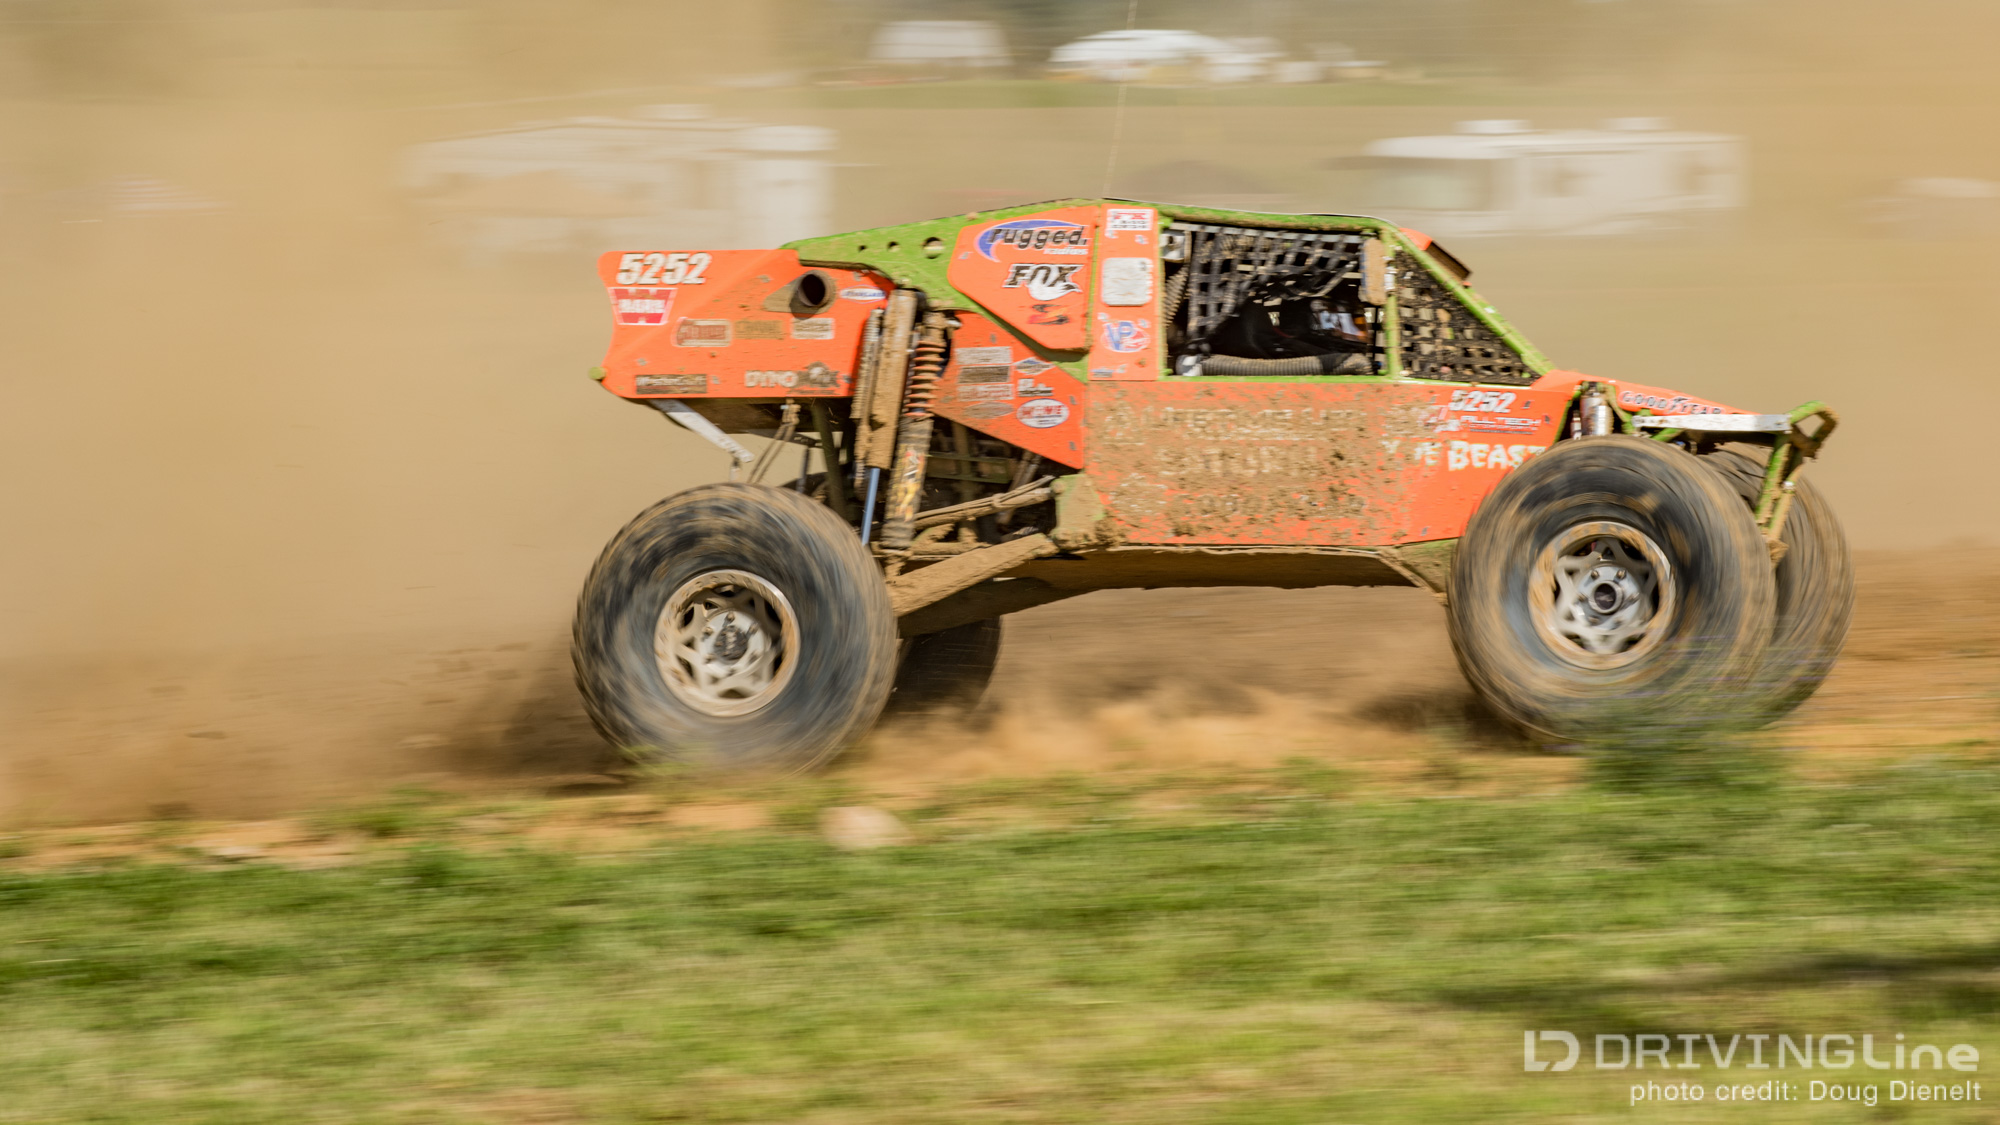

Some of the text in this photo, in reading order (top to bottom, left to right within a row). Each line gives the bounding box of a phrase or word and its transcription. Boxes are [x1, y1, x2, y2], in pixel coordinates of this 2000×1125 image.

[616, 252, 712, 285] 5252
[1002, 263, 1084, 288] FOX
[1448, 389, 1517, 413] 5252
